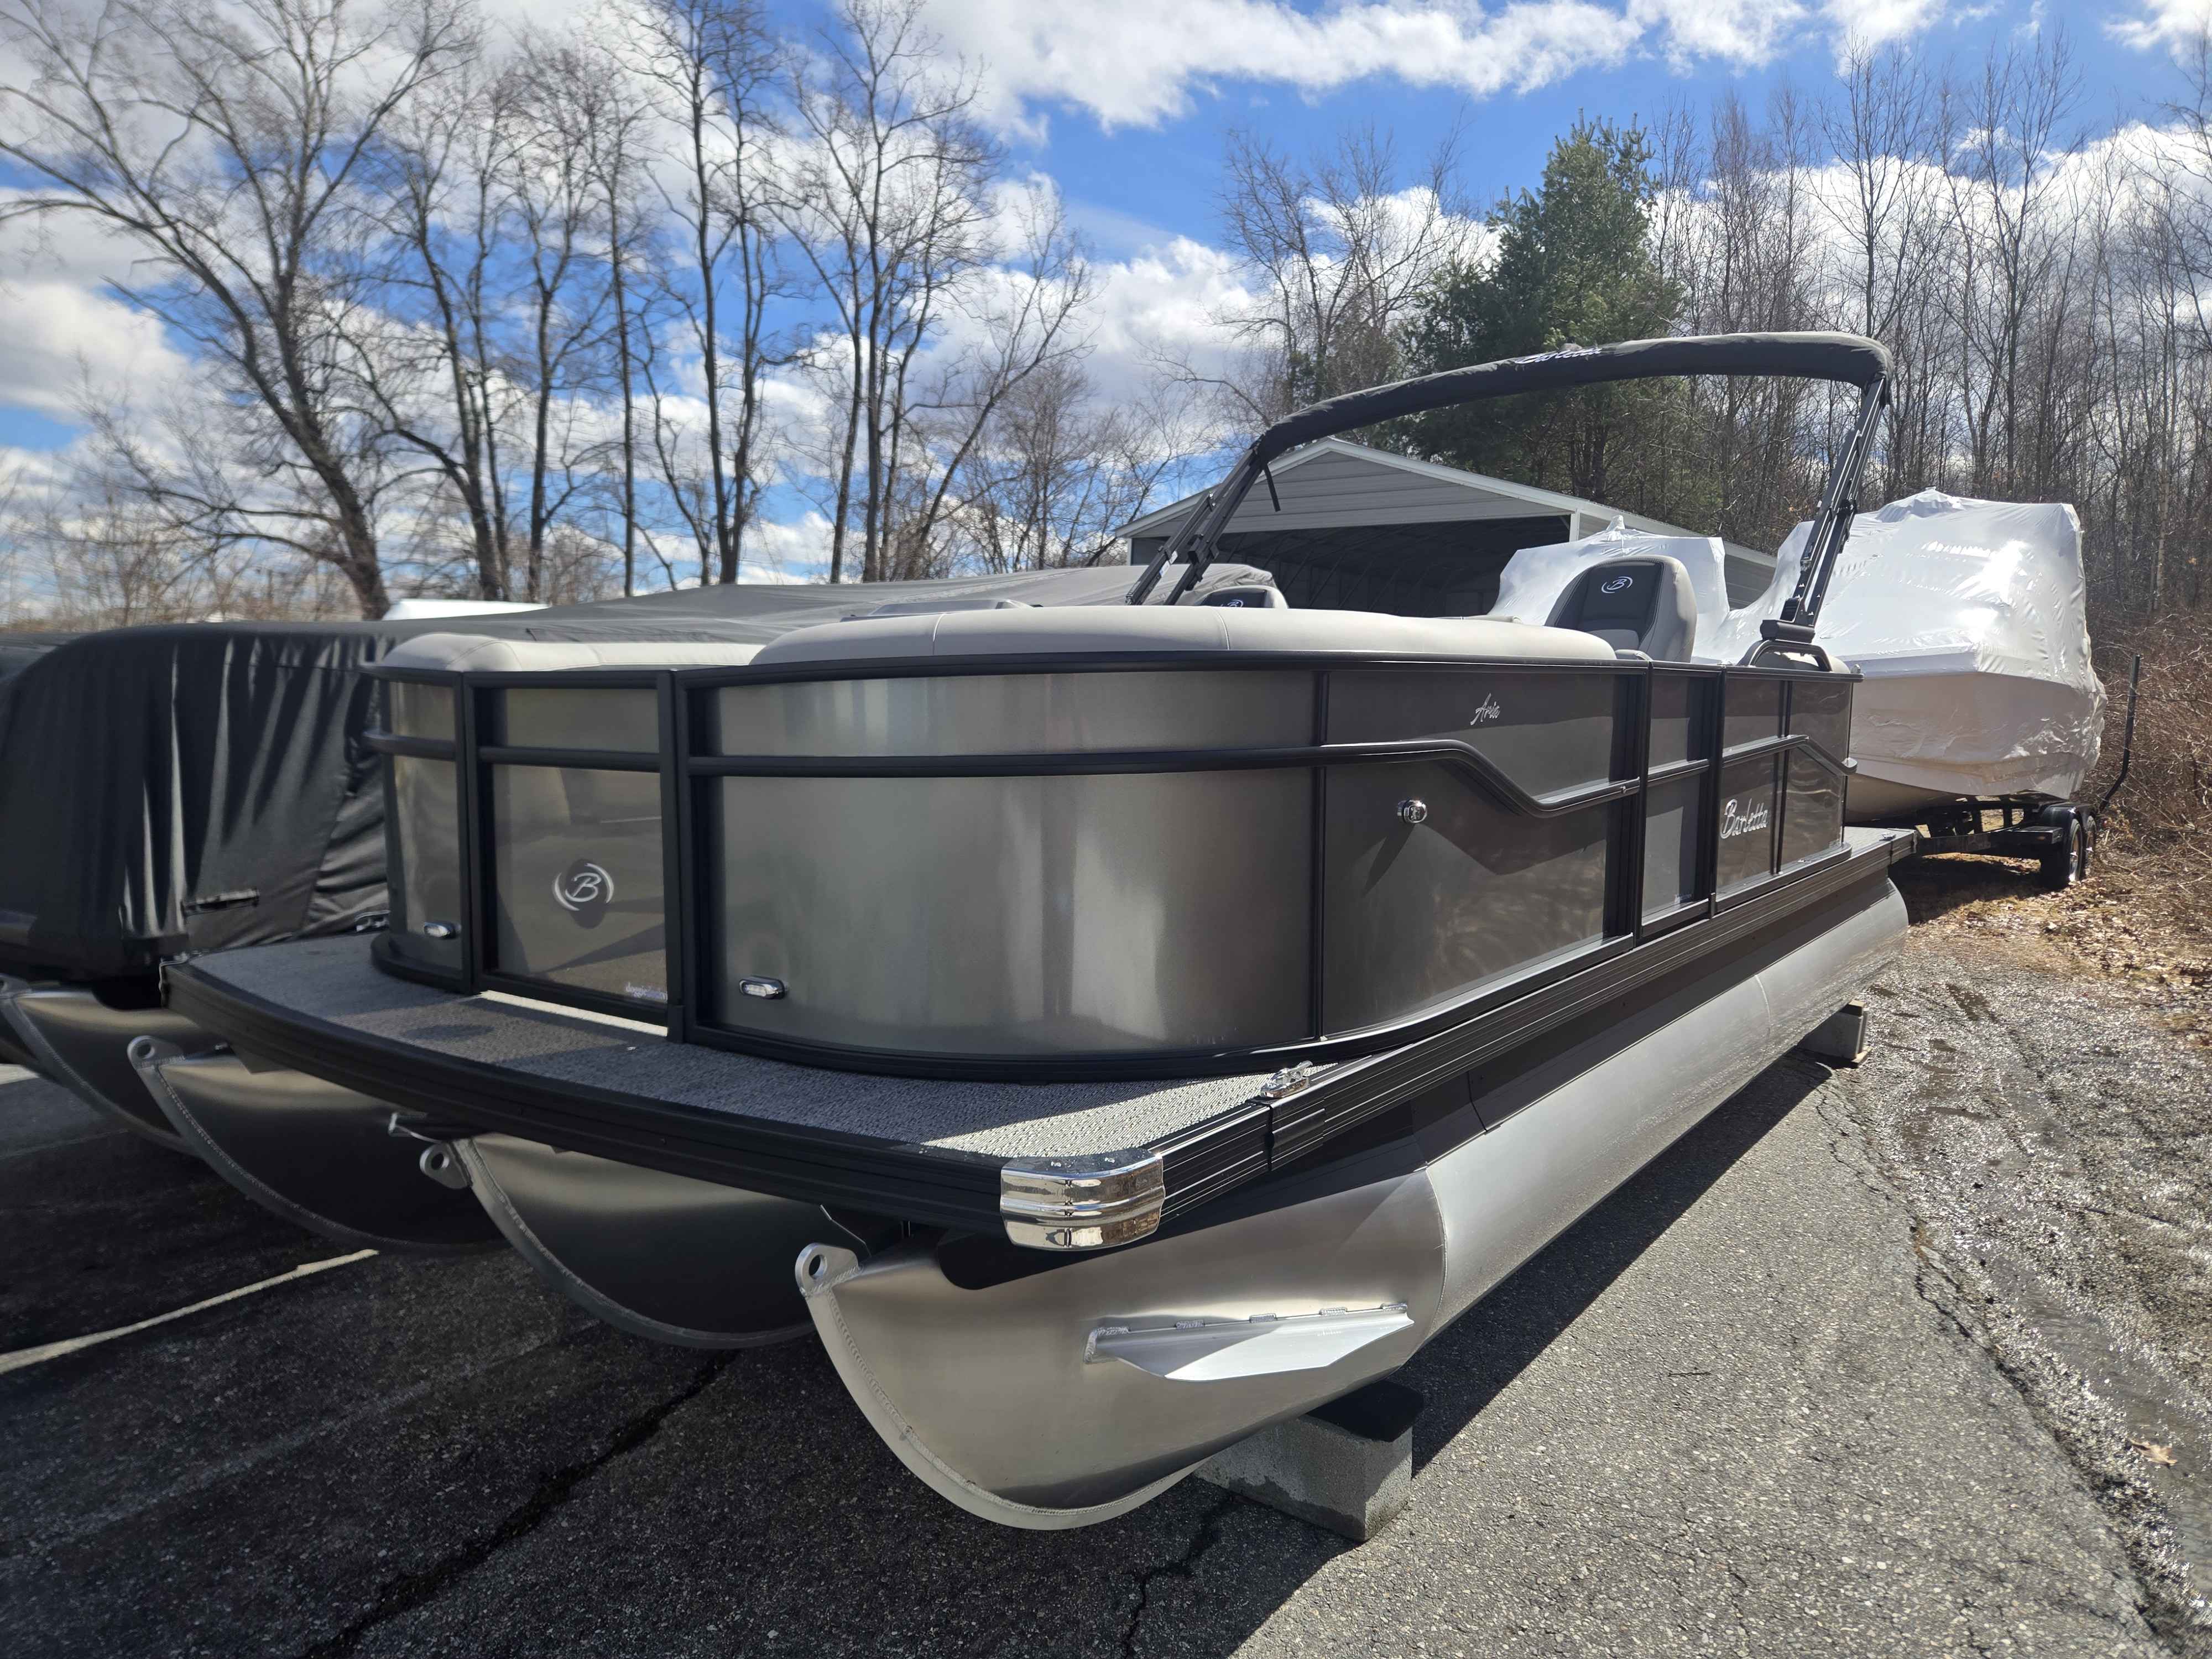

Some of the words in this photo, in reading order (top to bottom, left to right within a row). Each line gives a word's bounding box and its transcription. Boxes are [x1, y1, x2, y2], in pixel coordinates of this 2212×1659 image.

[1606, 578, 1627, 590] B
[1470, 692, 1500, 726] Aria
[1720, 798, 1768, 839] Barletta
[565, 872, 602, 902] B
